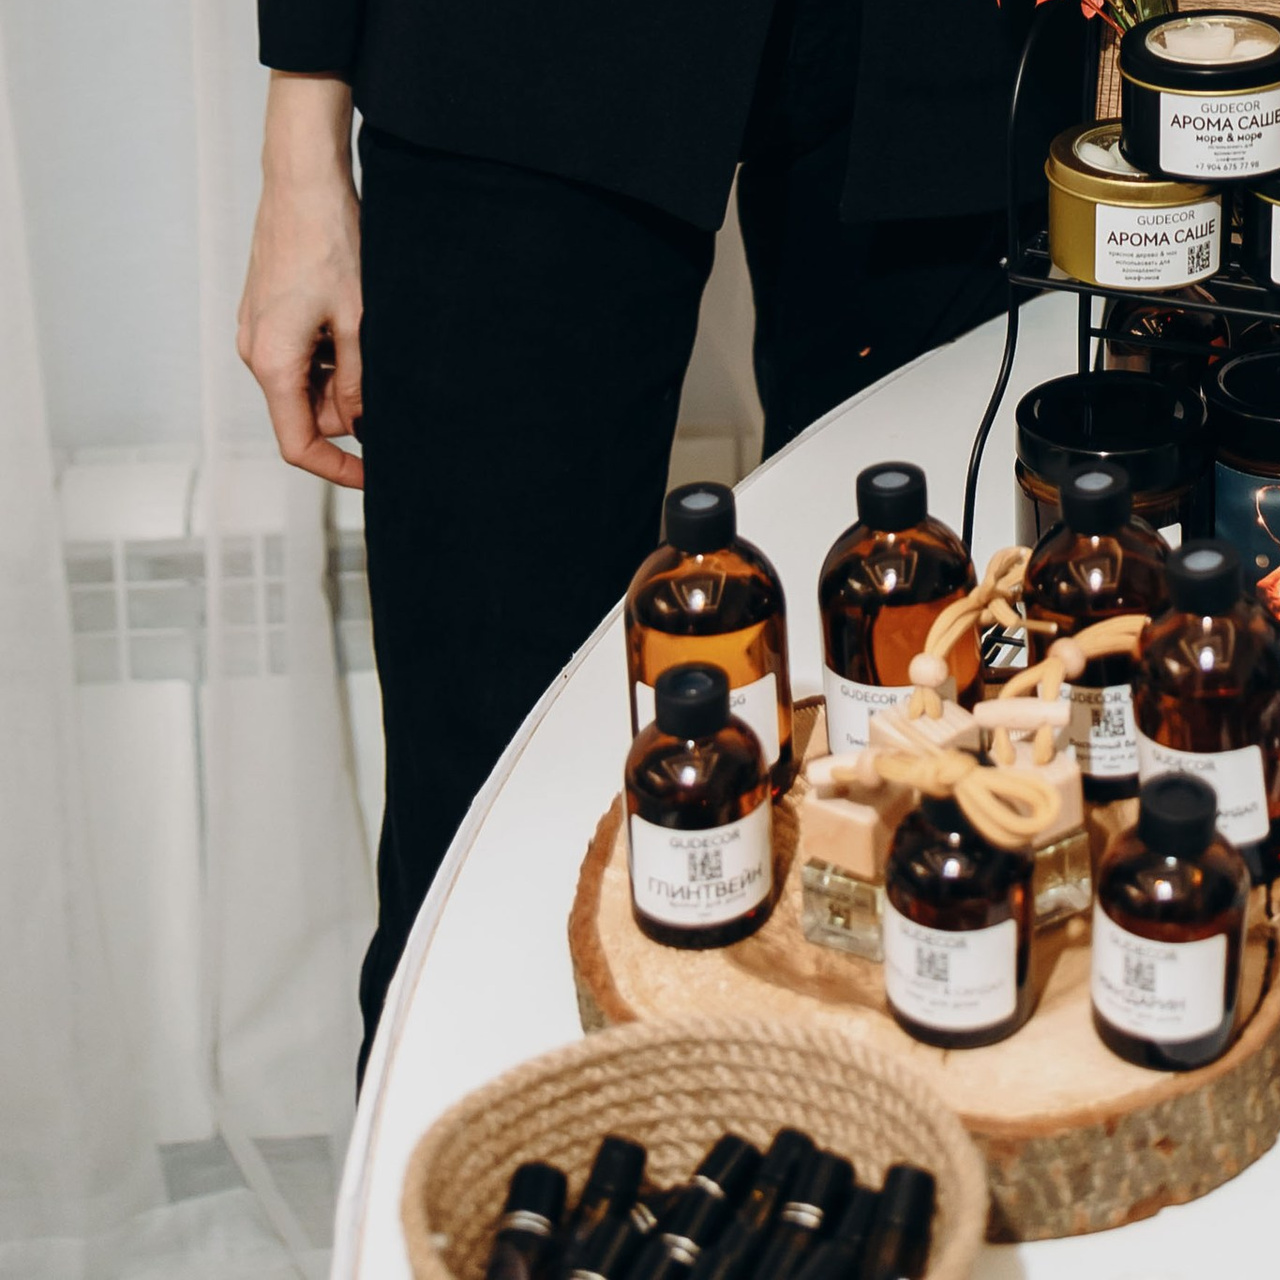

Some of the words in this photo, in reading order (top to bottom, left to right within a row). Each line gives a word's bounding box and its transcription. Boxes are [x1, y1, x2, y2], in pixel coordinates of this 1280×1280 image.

[1201, 100, 1260, 114] GUDECOR
[1170, 114, 1233, 131] АРОМА
[1196, 134, 1223, 144] море
[1237, 132, 1262, 143] море
[1137, 210, 1195, 226] GUDECOR
[1107, 231, 1170, 247] АРОМА
[1174, 218, 1215, 244] САШЕ
[648, 861, 763, 900] ГЛИНТВЕЙН
